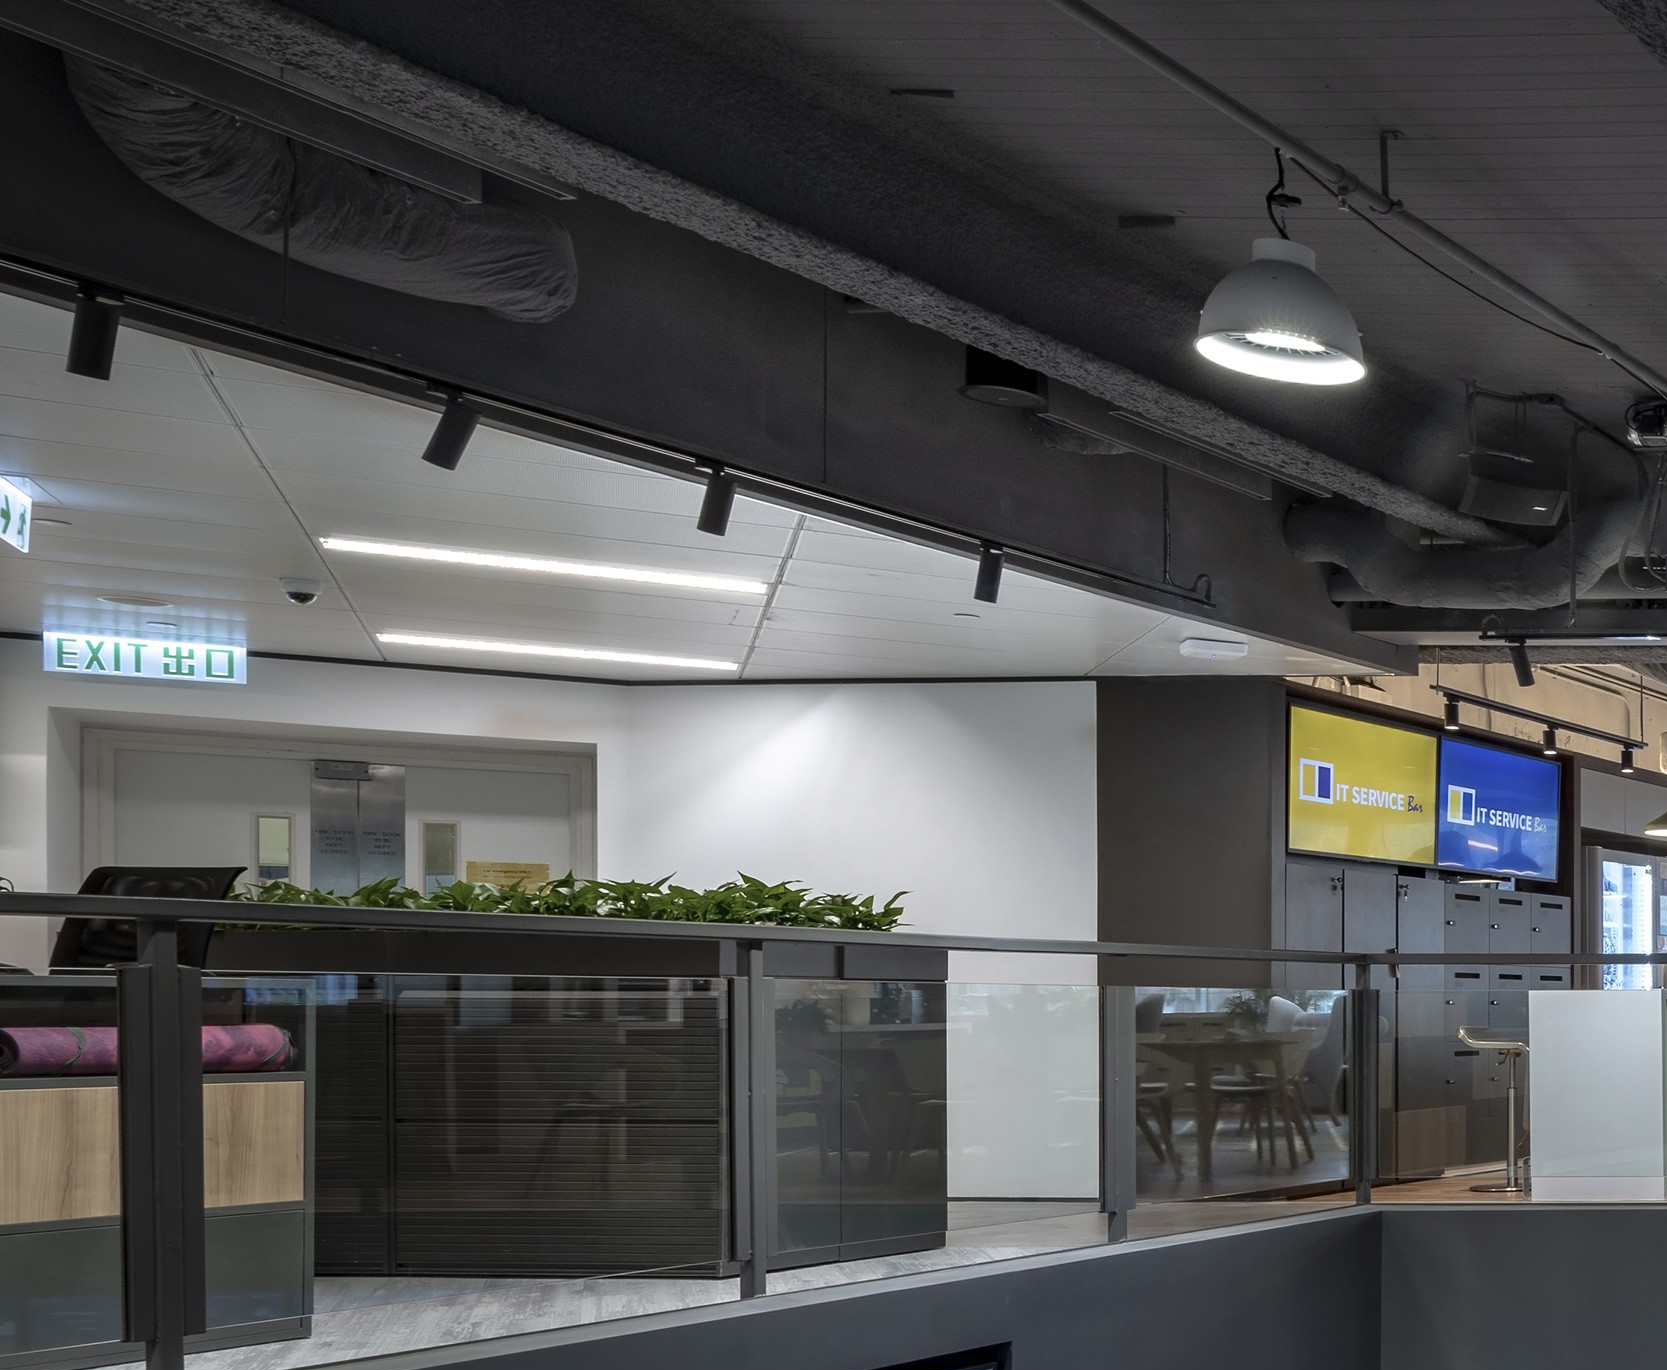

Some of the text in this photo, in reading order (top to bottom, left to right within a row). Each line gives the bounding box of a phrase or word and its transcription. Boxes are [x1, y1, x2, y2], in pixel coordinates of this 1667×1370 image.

[56, 638, 148, 674] EXIT
[163, 646, 235, 680] 出口
[1336, 784, 1423, 813] IT SERVICE Bar
[1477, 807, 1547, 833] IT SERVICE Bar
